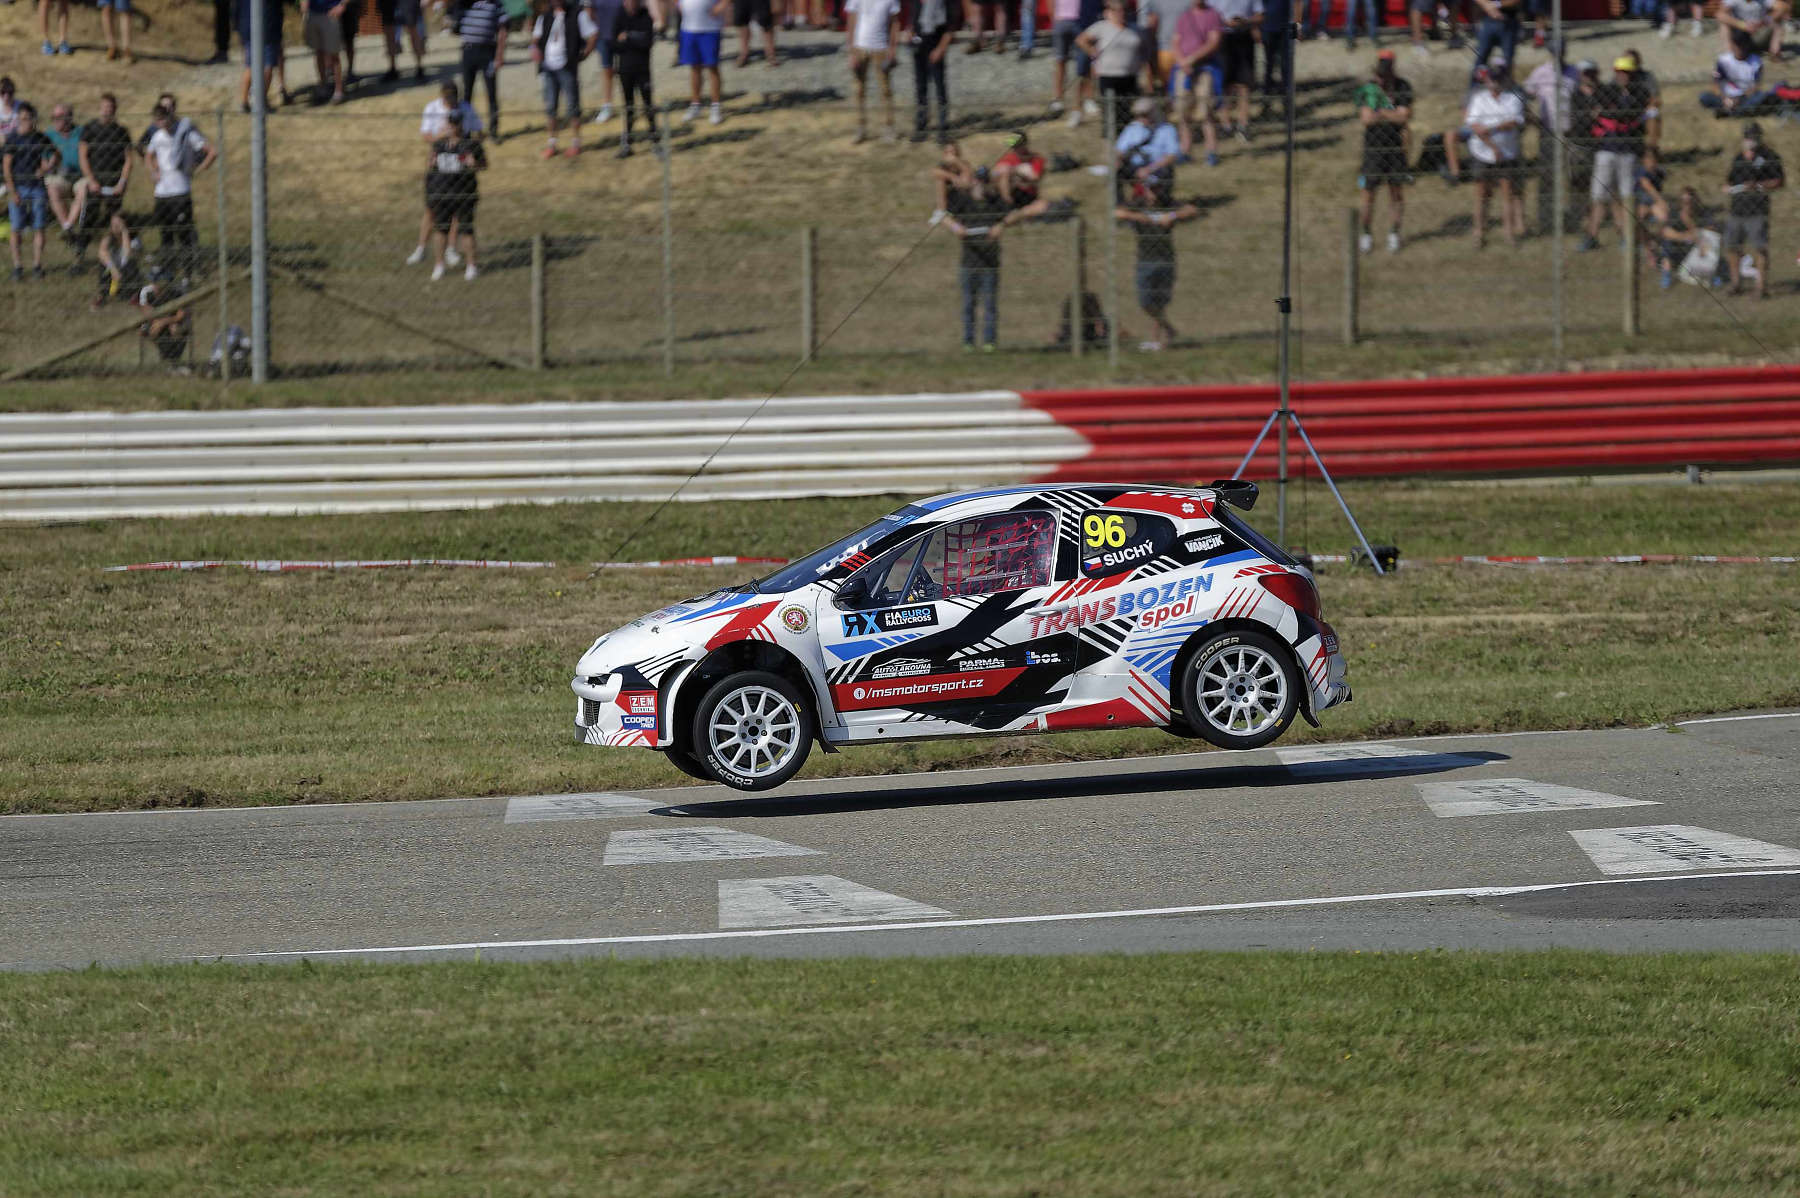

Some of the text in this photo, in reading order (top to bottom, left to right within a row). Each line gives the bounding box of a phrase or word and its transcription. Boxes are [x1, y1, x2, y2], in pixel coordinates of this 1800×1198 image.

[1083, 514, 1126, 548] 96
[1102, 539, 1154, 566] SUCHÝ
[885, 615, 932, 627] RALLYCROSS
[1141, 595, 1194, 628] spol
[1195, 636, 1240, 670] COOPER
